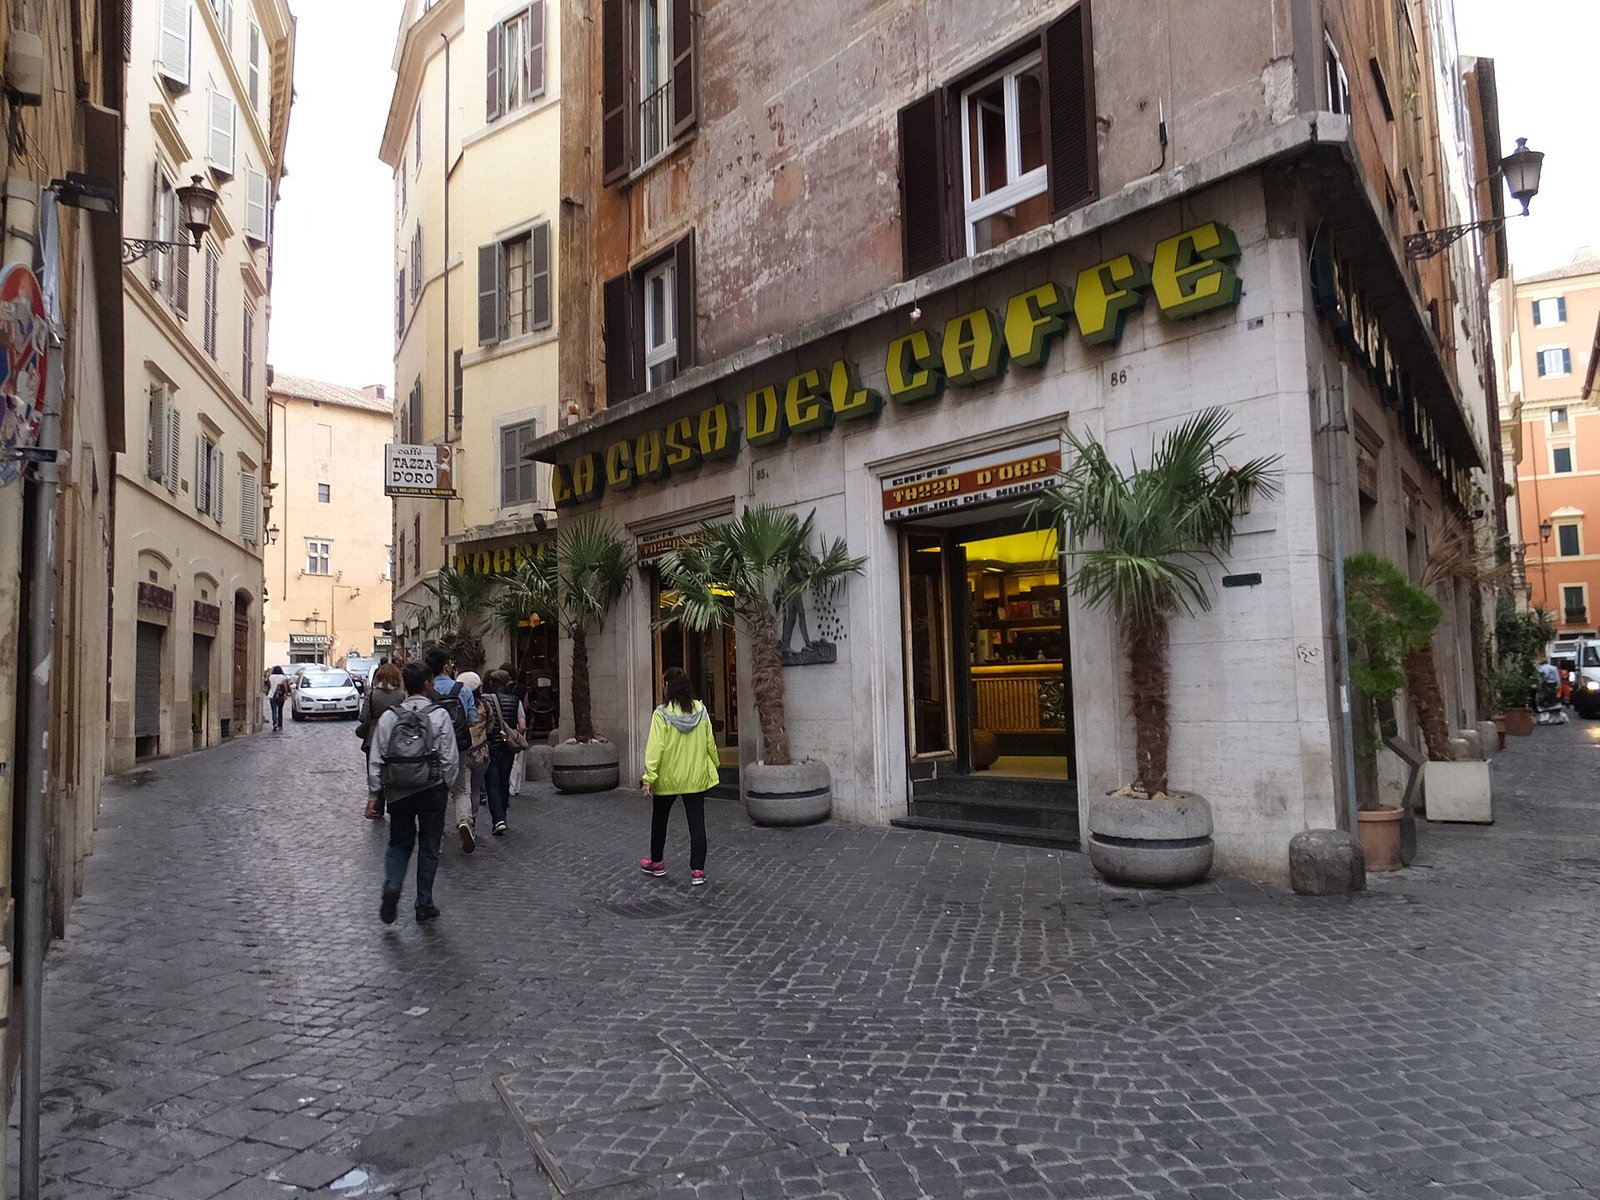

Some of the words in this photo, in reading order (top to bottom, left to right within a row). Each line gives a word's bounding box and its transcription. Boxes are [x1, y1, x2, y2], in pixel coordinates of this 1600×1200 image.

[551, 453, 595, 502] LA
[606, 403, 729, 487] CASA
[746, 359, 868, 440] DEL
[885, 222, 1223, 396] CAFFE
[1110, 369, 1127, 387] 86
[392, 457, 434, 471] TAZZA
[392, 471, 434, 484] D'ORO
[893, 477, 960, 503] TAZZA
[976, 457, 1047, 486] D'ORO
[889, 510, 904, 520] EL
[908, 498, 959, 516] MEJOR
[963, 492, 992, 504] DEL
[996, 478, 1056, 498] MUNDO
